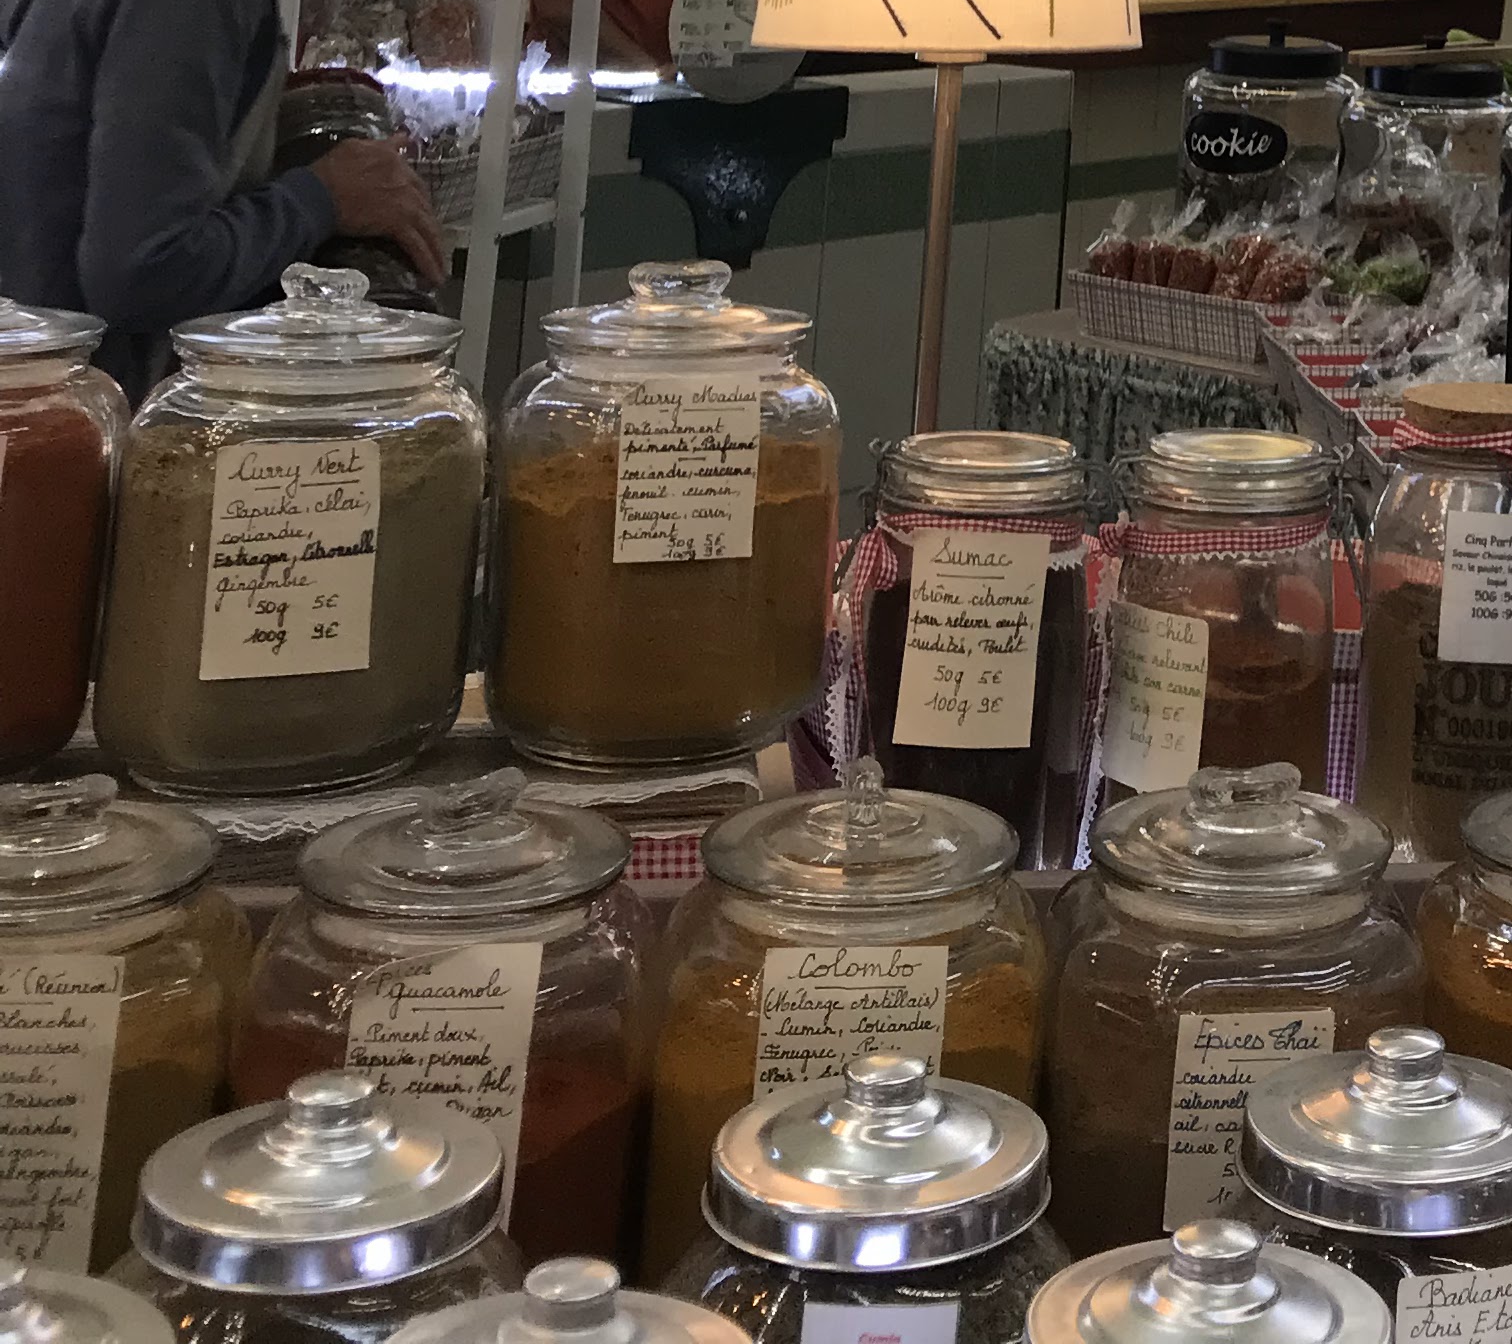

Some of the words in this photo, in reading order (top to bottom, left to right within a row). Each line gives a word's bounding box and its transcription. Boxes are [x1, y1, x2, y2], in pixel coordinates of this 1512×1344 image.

[1191, 128, 1273, 158] cookie
[627, 385, 682, 424] Curry
[692, 384, 757, 404] Madras
[623, 416, 724, 436] Délicatement
[228, 452, 301, 499] Curry
[311, 447, 364, 477] Vert
[618, 523, 678, 551] piment
[930, 537, 1013, 566] Sumac
[1464, 533, 1488, 548] Cinq
[913, 579, 964, 607] Arôme
[969, 583, 1036, 607] citronné
[1474, 590, 1498, 603] 50G
[254, 599, 291, 628] 50g
[312, 593, 340, 610] 5€
[910, 609, 943, 634] pour
[1471, 607, 1499, 620] 100G
[243, 627, 288, 656] 100g
[311, 621, 340, 641] 9€
[933, 665, 965, 696] 50g
[977, 670, 1003, 685] 5€
[924, 692, 973, 727] 100g
[977, 697, 1004, 714] 9€
[1162, 707, 1186, 722] 5€
[788, 947, 922, 980] Colombo
[382, 968, 512, 1020] guacamole
[363, 1021, 434, 1043] Piment
[1194, 1017, 1265, 1064] Epices
[1268, 1019, 1328, 1051] Thaï
[427, 1043, 492, 1078] piment
[1410, 1309, 1462, 1338] Anis
